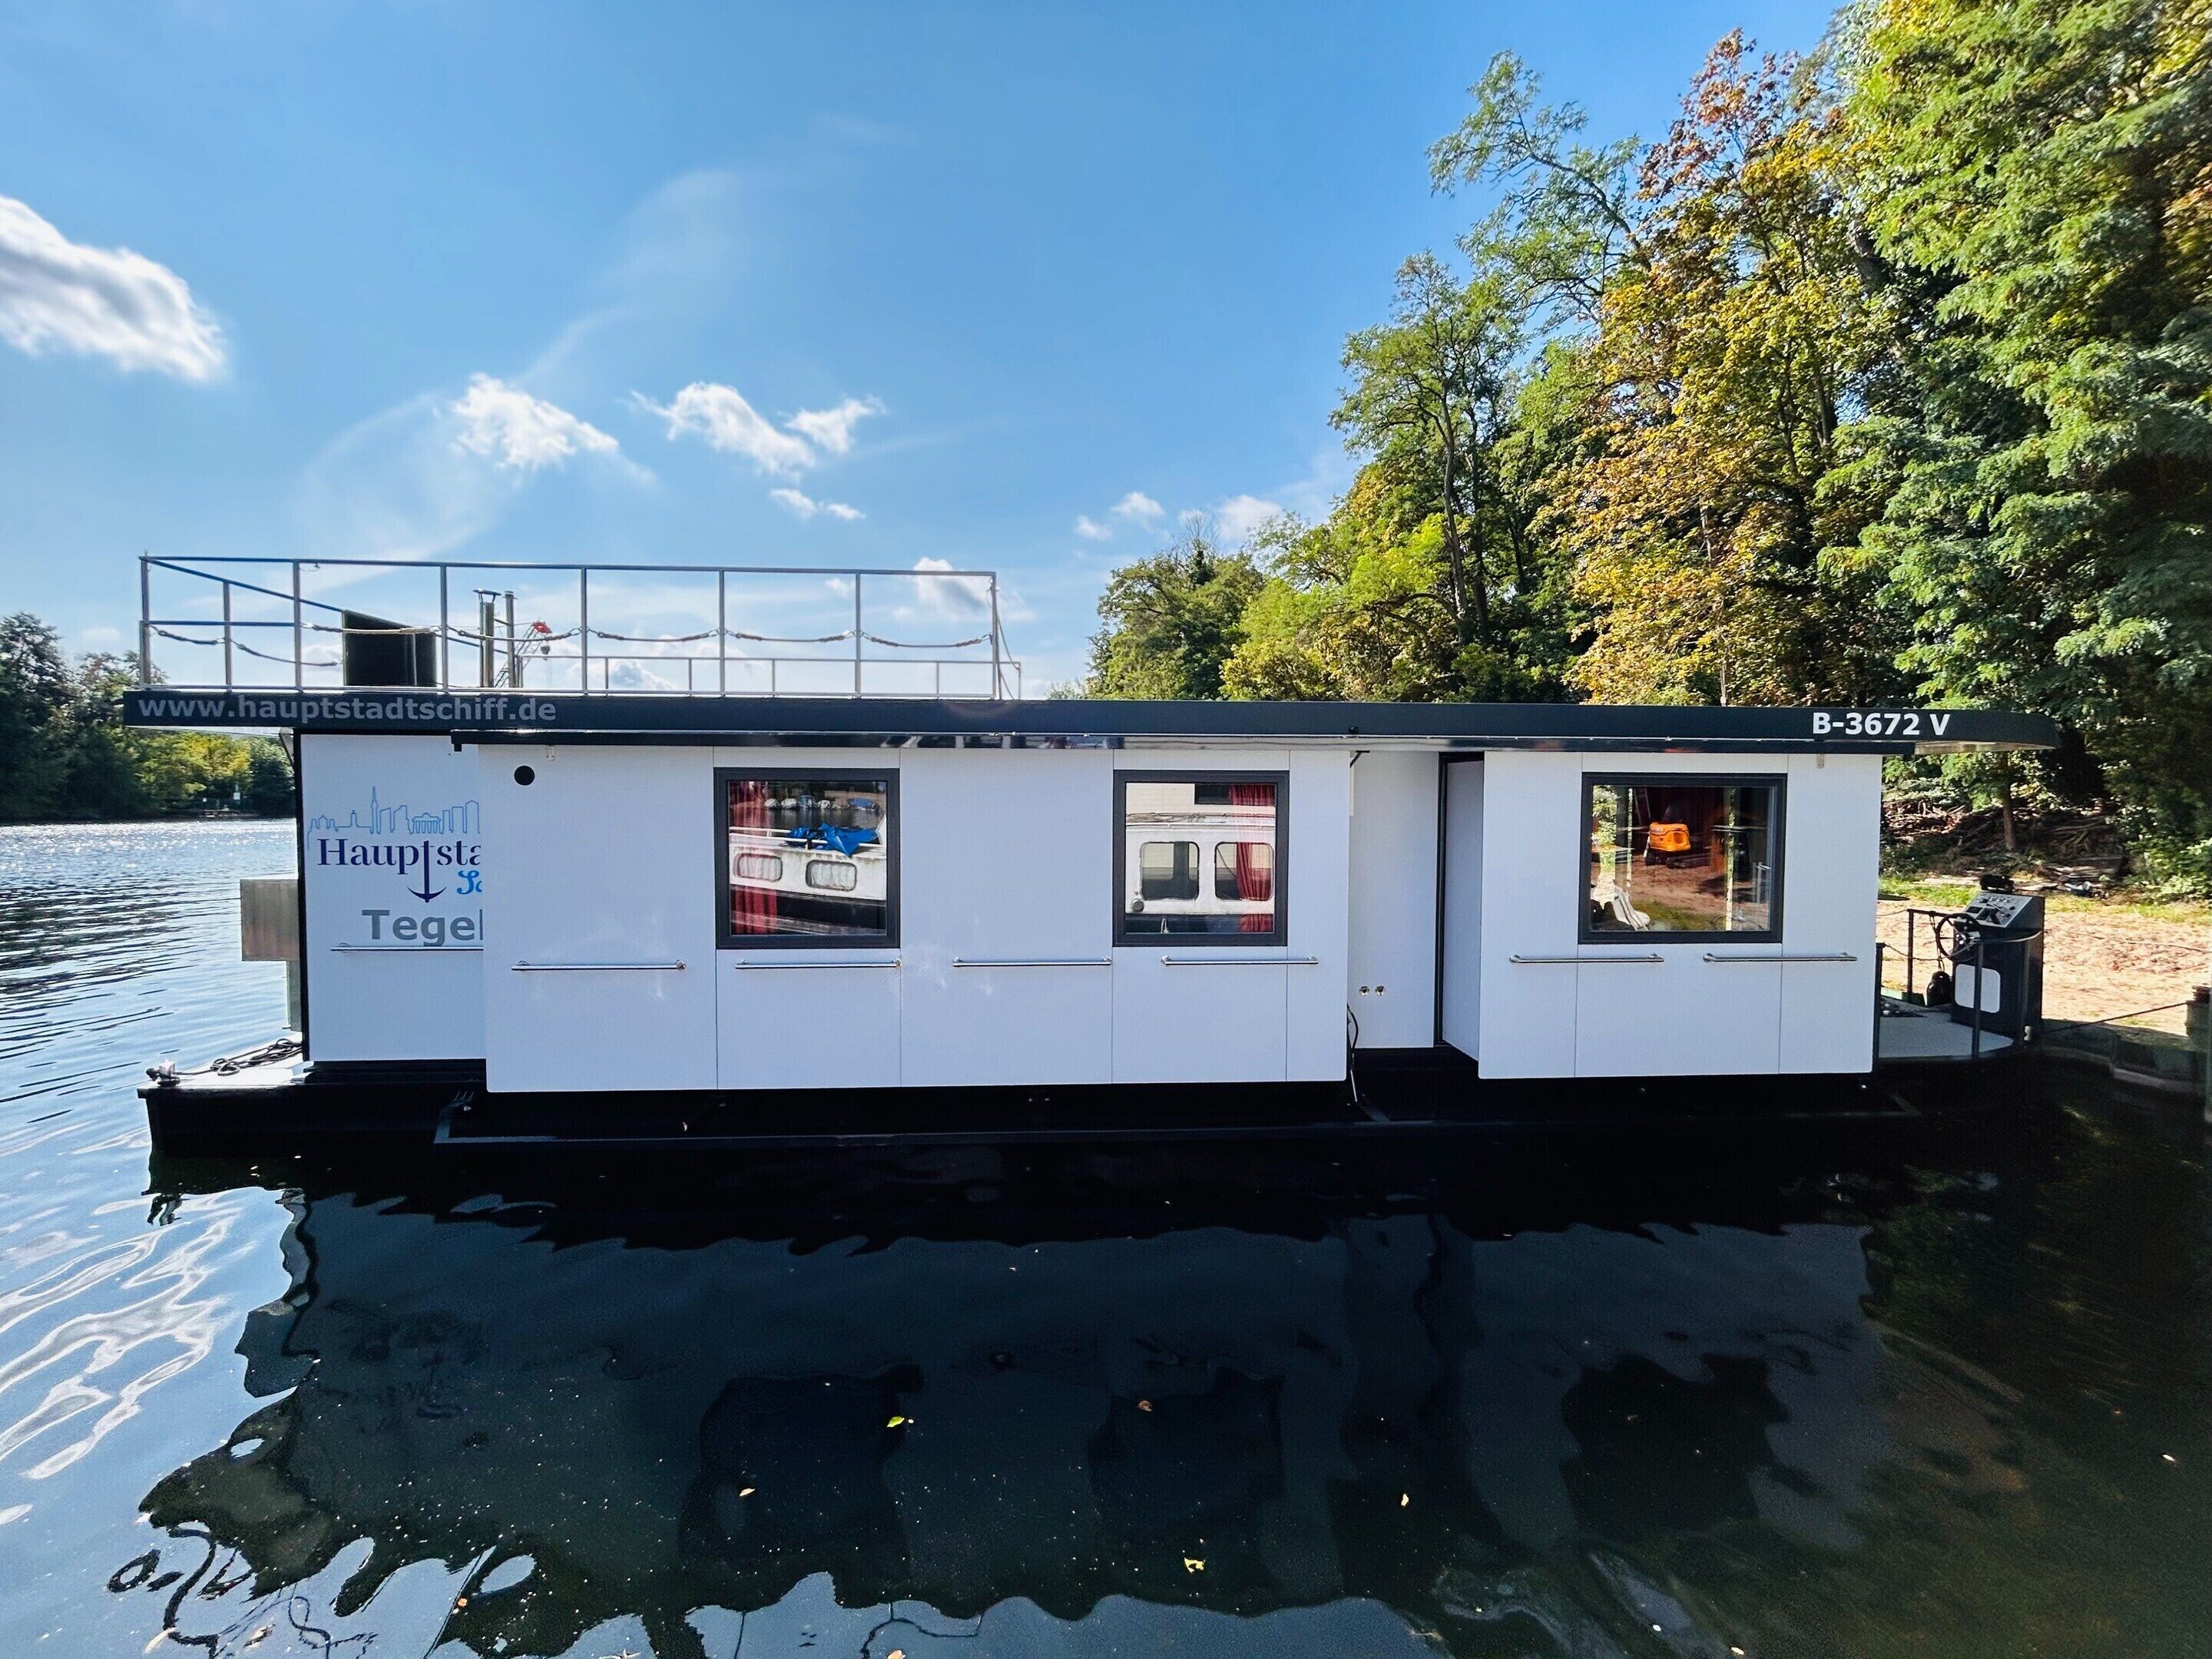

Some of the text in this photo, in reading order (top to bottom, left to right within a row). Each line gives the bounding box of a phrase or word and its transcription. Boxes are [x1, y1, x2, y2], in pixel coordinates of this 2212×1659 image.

[137, 694, 556, 724] www.hauptstadtschiff.de
[1813, 712, 1951, 735] B-3672 V
